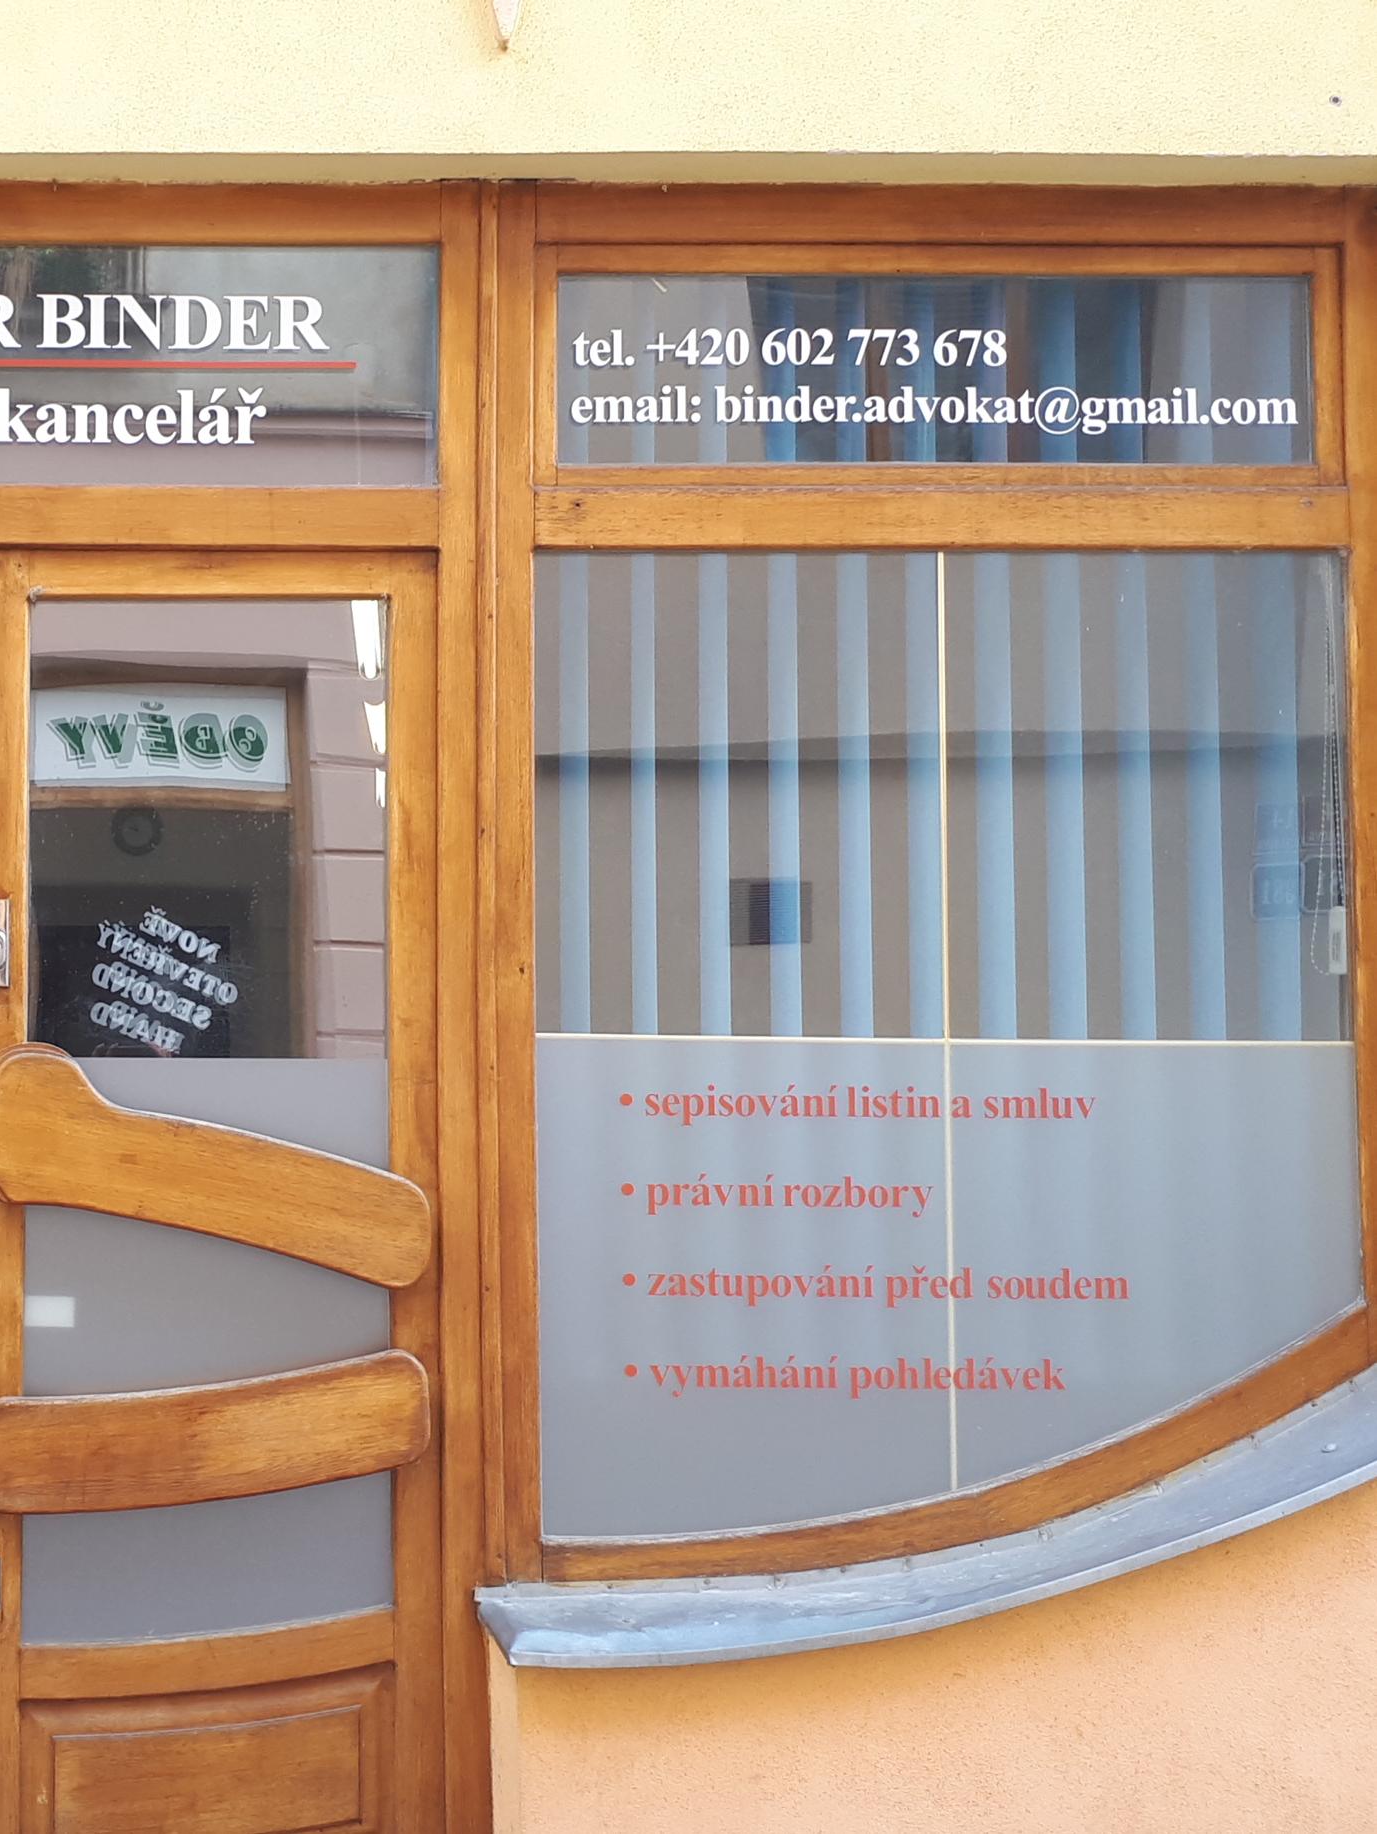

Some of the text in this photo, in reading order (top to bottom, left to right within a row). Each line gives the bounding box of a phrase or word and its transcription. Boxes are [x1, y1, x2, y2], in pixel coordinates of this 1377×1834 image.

[36, 294, 330, 350] BINDER
[572, 328, 1007, 367] tel. +420 602 773 678
[571, 384, 1299, 435] email: binder.advokat@gmail.com
[645, 1082, 1095, 1128] sepisování listin a smluv
[647, 1172, 933, 1218] právní rozbory
[648, 1263, 1130, 1309] zastupování před soudem
[649, 1353, 1067, 1401] vymáhání pohledávek
